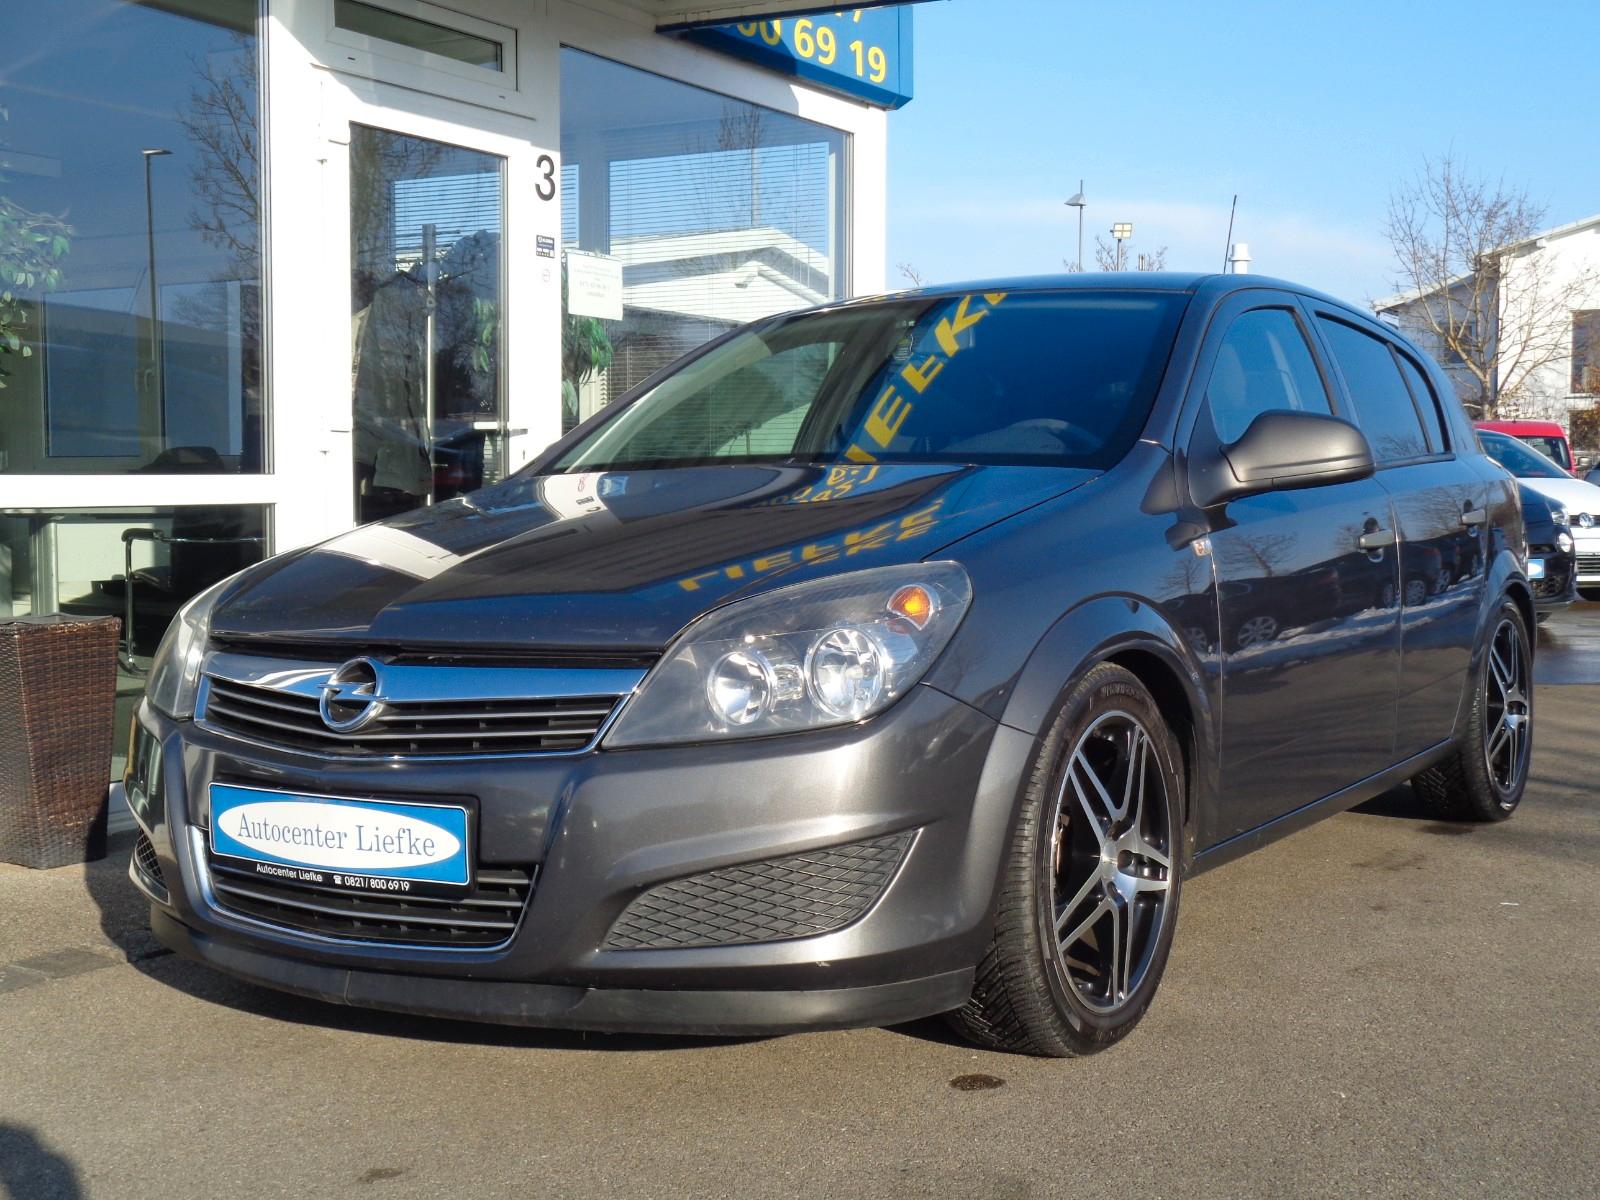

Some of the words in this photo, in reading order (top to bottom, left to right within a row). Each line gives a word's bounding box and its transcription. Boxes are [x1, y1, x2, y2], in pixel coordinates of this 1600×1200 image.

[794, 19, 836, 65] 69
[850, 40, 886, 84] 19
[535, 154, 556, 202] 3
[237, 812, 348, 850] Autocenter
[355, 824, 436, 857] Liefke
[256, 863, 297, 879] Autocenter
[299, 869, 323, 882] Liefke
[370, 878, 387, 890] 800
